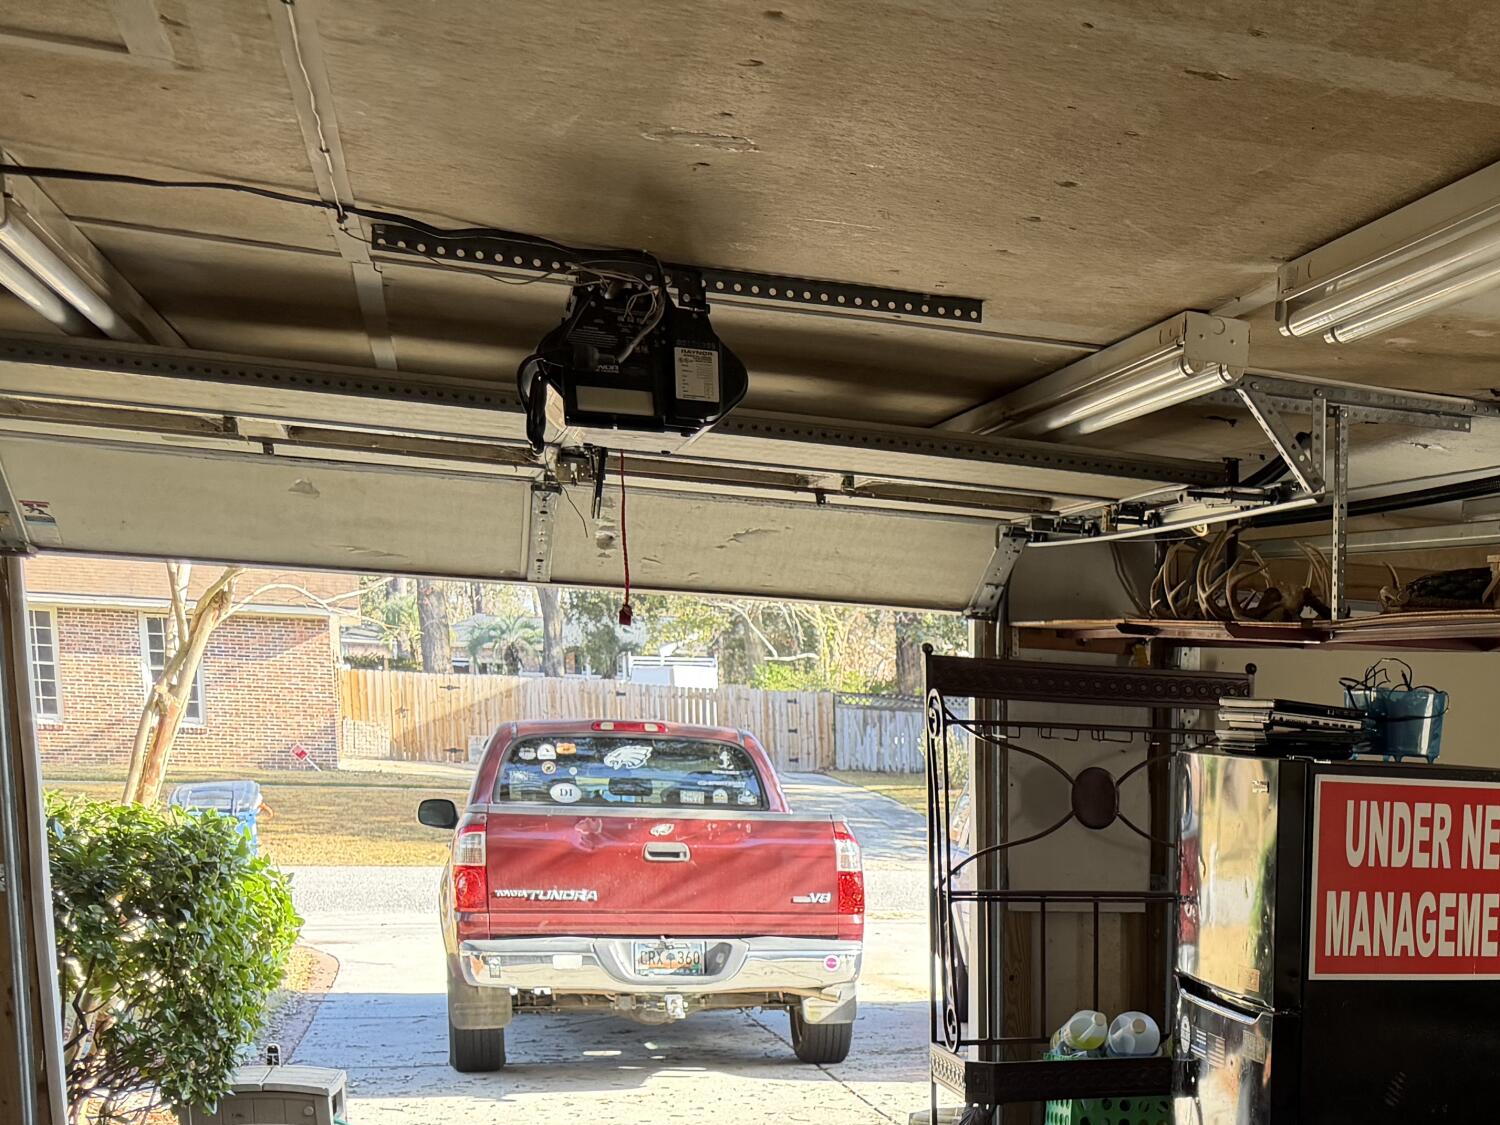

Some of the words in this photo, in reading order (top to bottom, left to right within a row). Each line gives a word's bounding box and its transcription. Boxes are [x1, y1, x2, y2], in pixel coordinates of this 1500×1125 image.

[681, 348, 713, 357] RAYNOR
[1345, 799, 1452, 869] UNDER
[526, 889, 599, 902] TUNDRA
[809, 891, 832, 904] V8
[677, 950, 700, 965] 360
